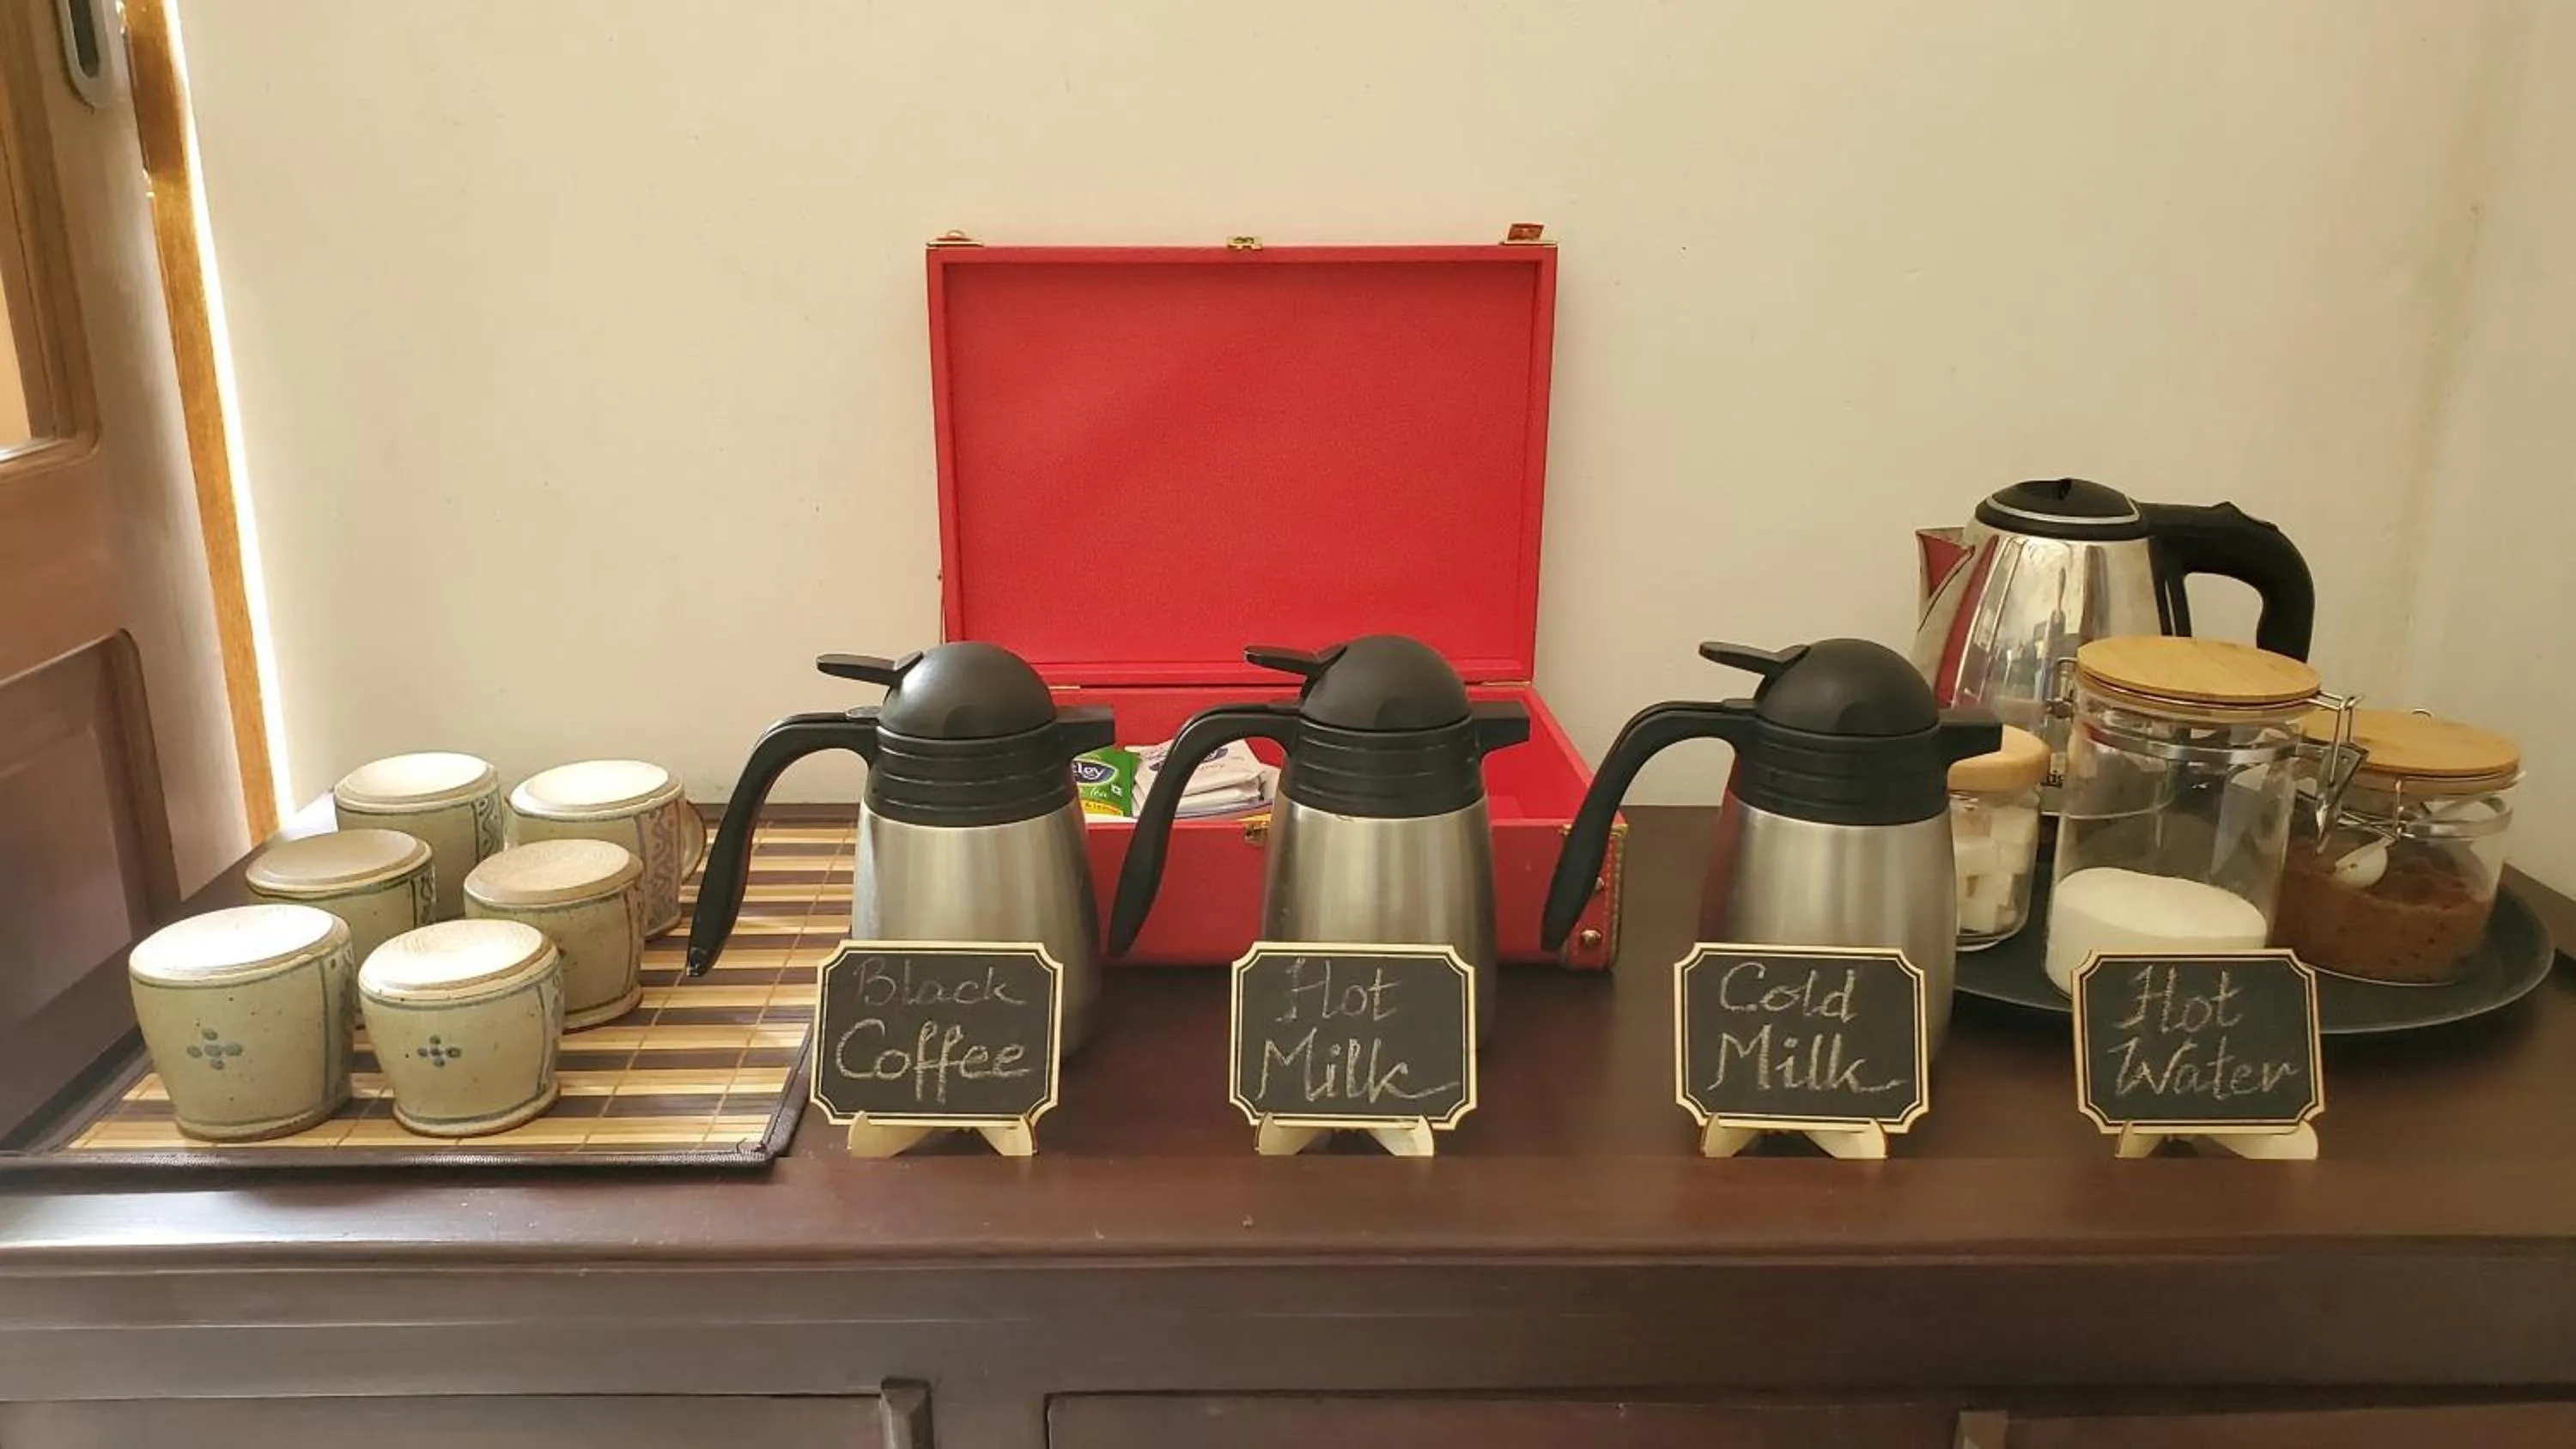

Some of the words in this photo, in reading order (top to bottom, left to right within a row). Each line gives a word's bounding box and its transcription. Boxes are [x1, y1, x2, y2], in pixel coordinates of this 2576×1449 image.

[854, 956, 1027, 1006] Black
[1276, 957, 1401, 1022] Hot
[1720, 961, 1857, 1022] Cold
[2113, 965, 2243, 1034] Hot
[835, 1018, 1030, 1105] Coffee
[1254, 1028, 1460, 1104] Milk
[1707, 1024, 1909, 1094] Milk
[2106, 1036, 2305, 1101] Water
